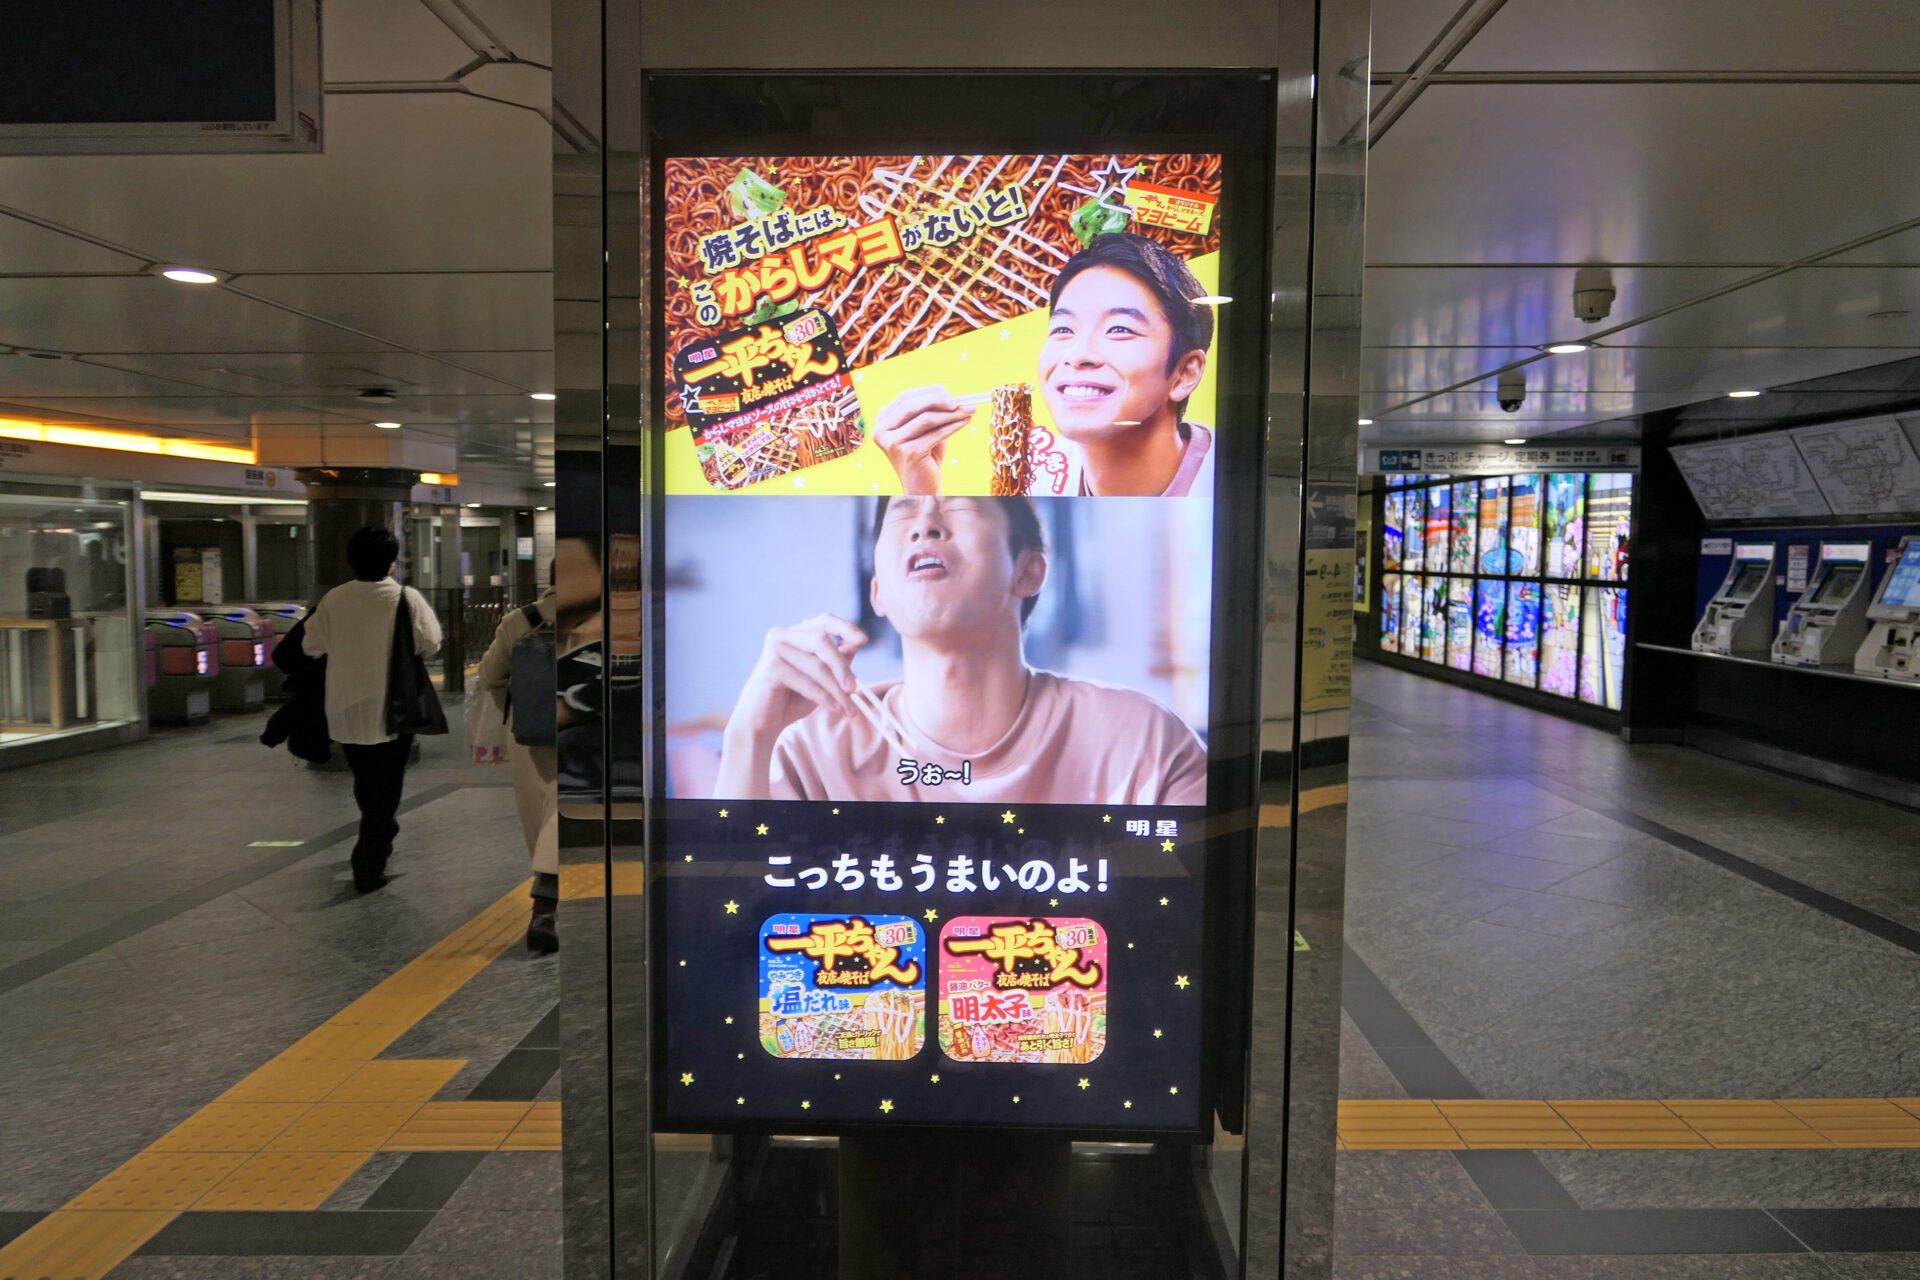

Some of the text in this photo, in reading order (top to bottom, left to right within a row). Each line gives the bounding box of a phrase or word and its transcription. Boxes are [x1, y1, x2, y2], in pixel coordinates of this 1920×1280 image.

[1136, 206, 1204, 232] マヨビーム
[795, 319, 816, 342] 30
[683, 325, 840, 388] 一平ちゃん
[1126, 820, 1178, 837] 明星
[764, 853, 1109, 893] こっちもうまいのよ!
[885, 927, 906, 945] 30
[1066, 929, 1087, 947] 30
[768, 919, 919, 984] 一平ちゃん
[948, 921, 1100, 986] 一平ちゃん
